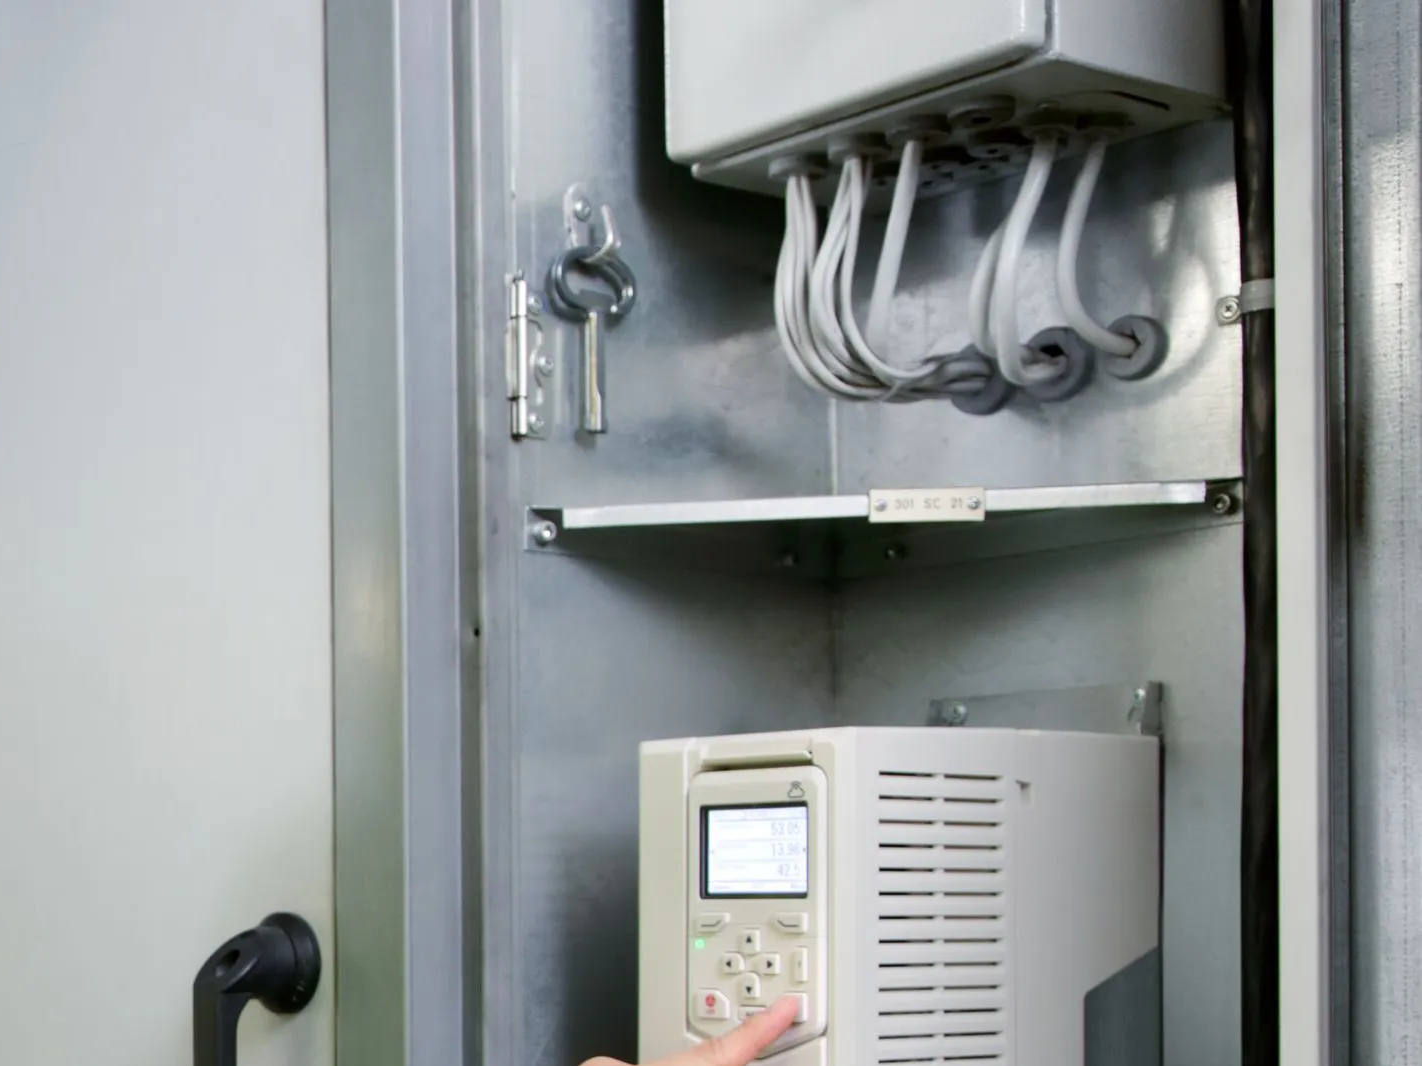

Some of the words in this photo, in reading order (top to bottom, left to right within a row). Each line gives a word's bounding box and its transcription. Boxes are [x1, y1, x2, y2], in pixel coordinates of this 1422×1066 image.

[894, 498, 915, 510] 301
[923, 497, 941, 509] SC
[949, 497, 963, 509] 21
